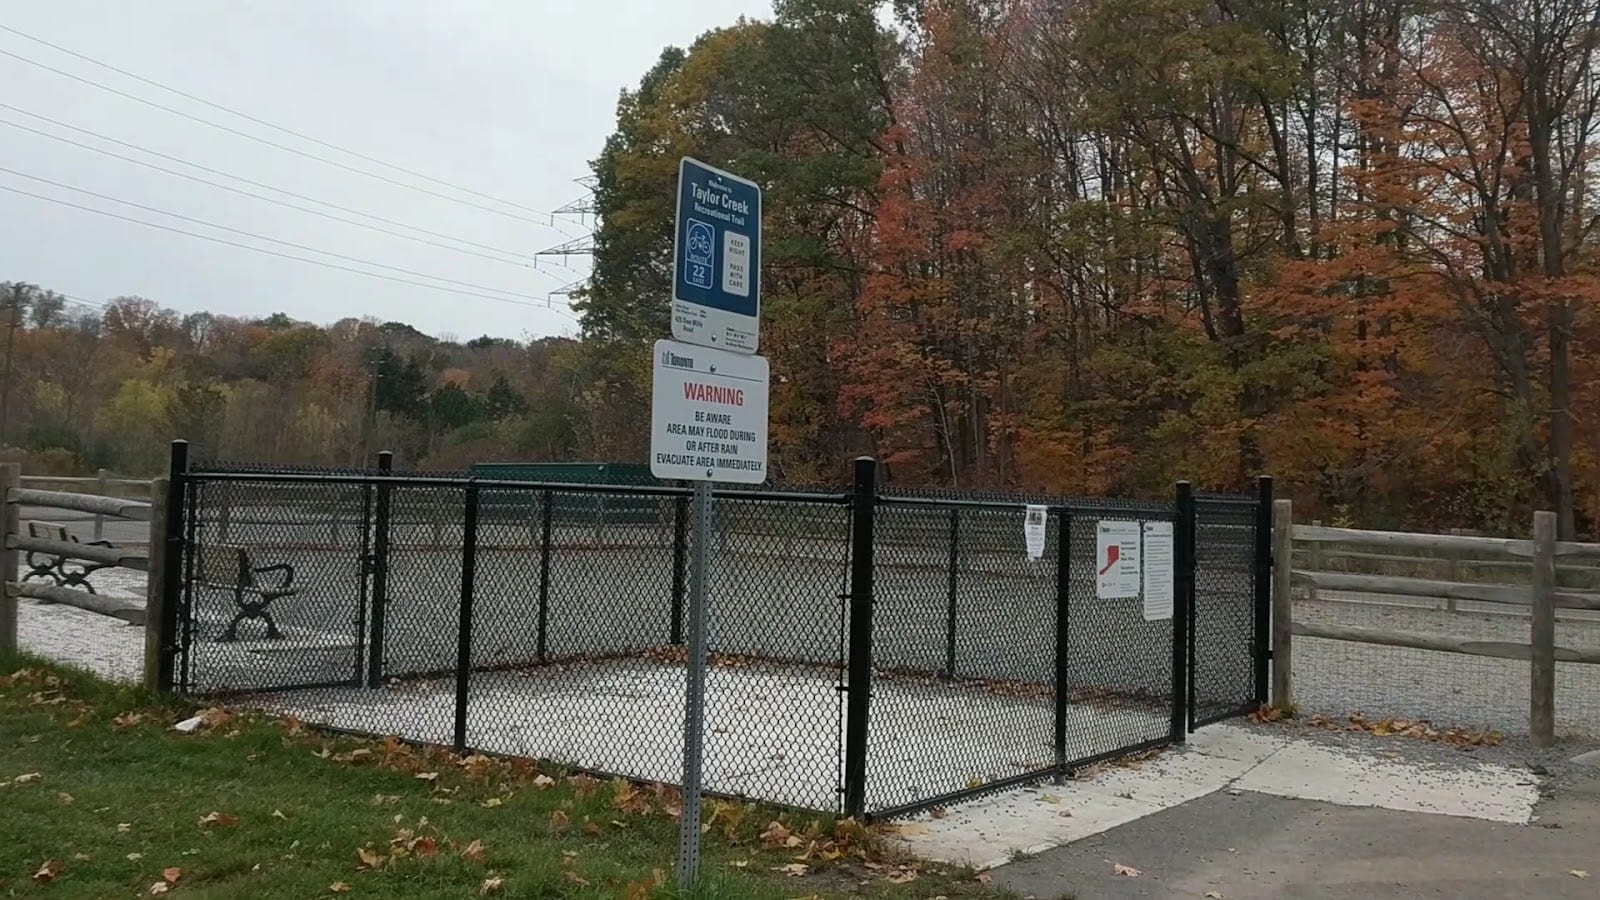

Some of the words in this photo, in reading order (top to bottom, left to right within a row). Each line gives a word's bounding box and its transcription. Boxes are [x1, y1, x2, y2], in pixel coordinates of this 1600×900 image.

[692, 182, 720, 205] Taylor
[722, 194, 749, 215] Creek
[694, 202, 730, 222] Recreational
[731, 214, 745, 226] Trail
[731, 239, 744, 247] KEEP
[729, 247, 745, 256] RIGHT
[690, 254, 708, 264] ROUTE
[692, 265, 705, 277] 22
[730, 264, 744, 272] PASS
[730, 272, 743, 280] WITH
[729, 279, 743, 288] CARE
[684, 382, 744, 406] WARNING
[695, 411, 704, 422] BE
[706, 413, 732, 425] AWARE
[666, 423, 687, 435] AREA
[688, 426, 704, 437] MAY
[706, 428, 728, 440] FLOOD
[730, 430, 756, 442] DURING
[686, 440, 696, 451] OR
[698, 442, 719, 453] AFTER
[721, 444, 738, 455] RAIN
[656, 453, 694, 466] EVACUATE
[696, 457, 716, 468] AREA
